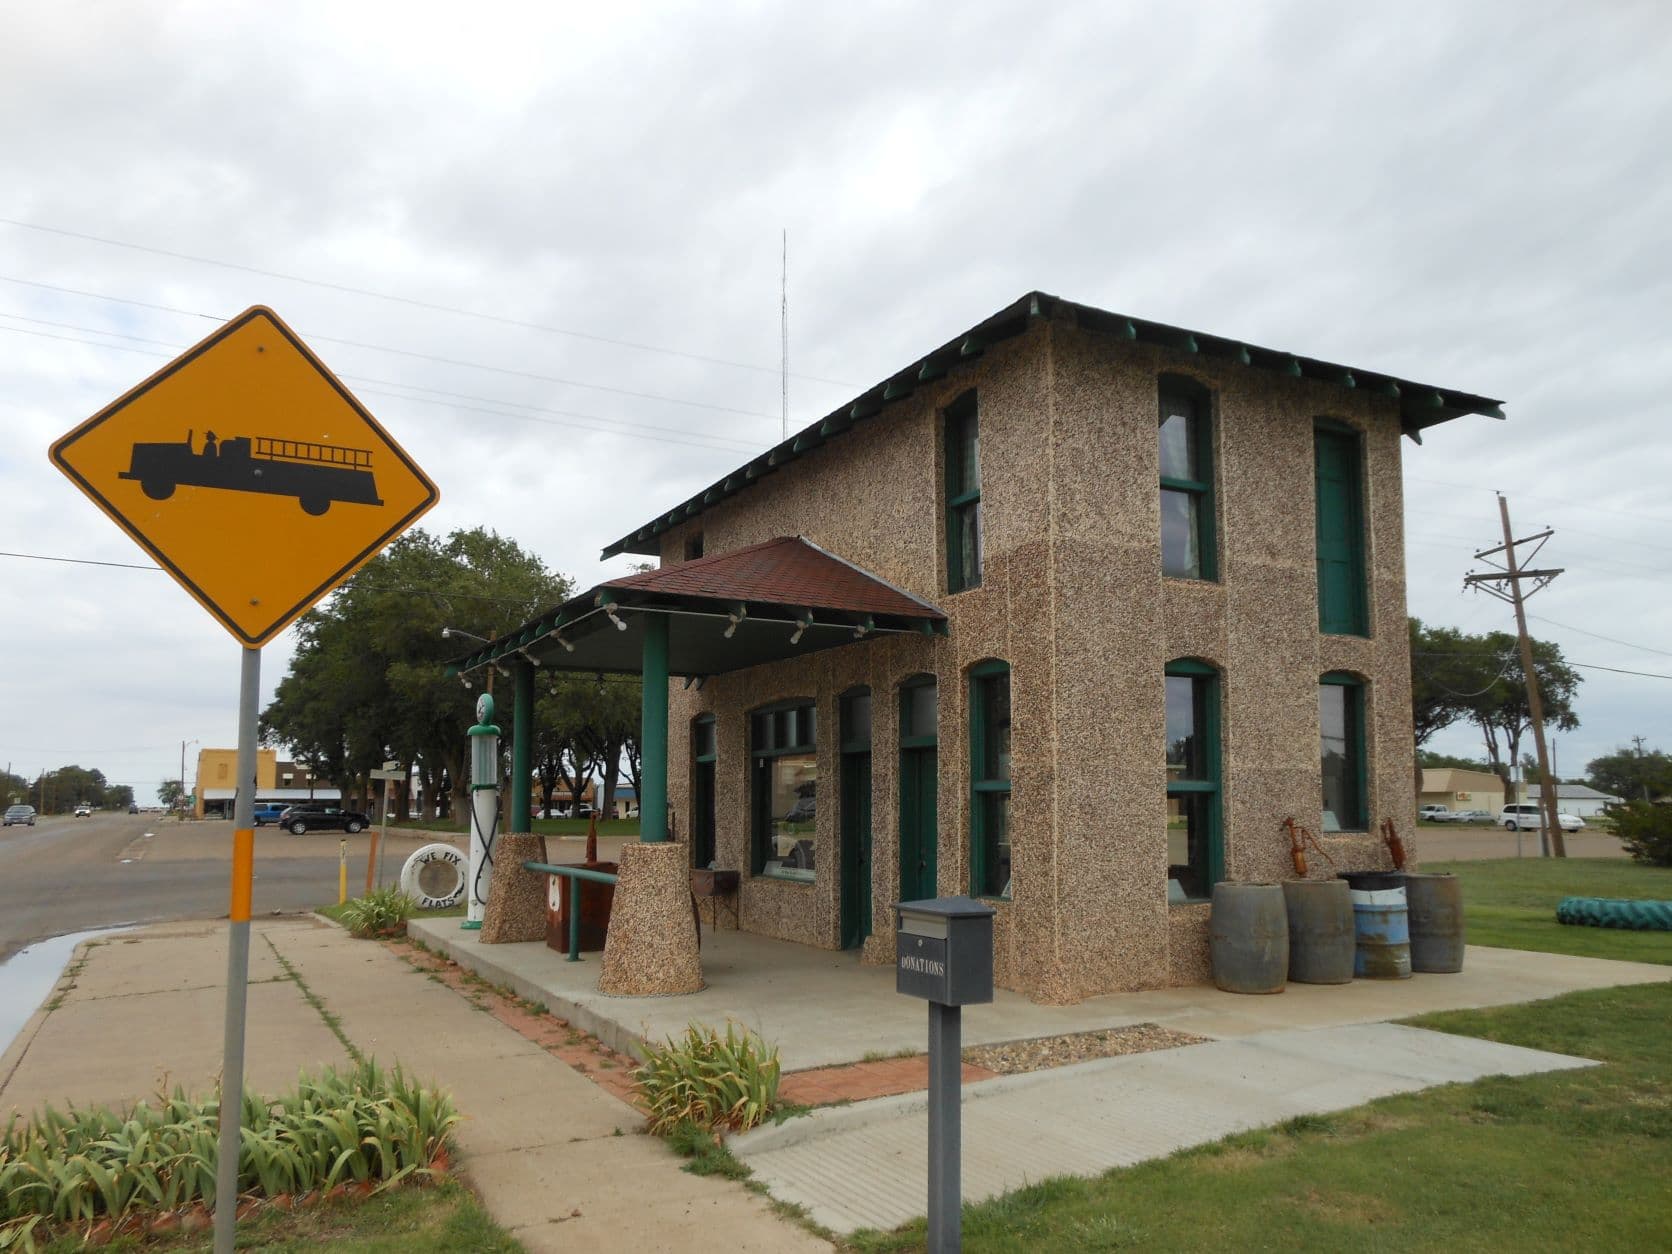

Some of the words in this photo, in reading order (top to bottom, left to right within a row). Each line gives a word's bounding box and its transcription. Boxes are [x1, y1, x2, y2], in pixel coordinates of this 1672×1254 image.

[420, 852, 437, 864] WE
[443, 852, 461, 866] FIX
[421, 897, 455, 909] FLATS
[901, 956, 944, 976] DONATIONS
